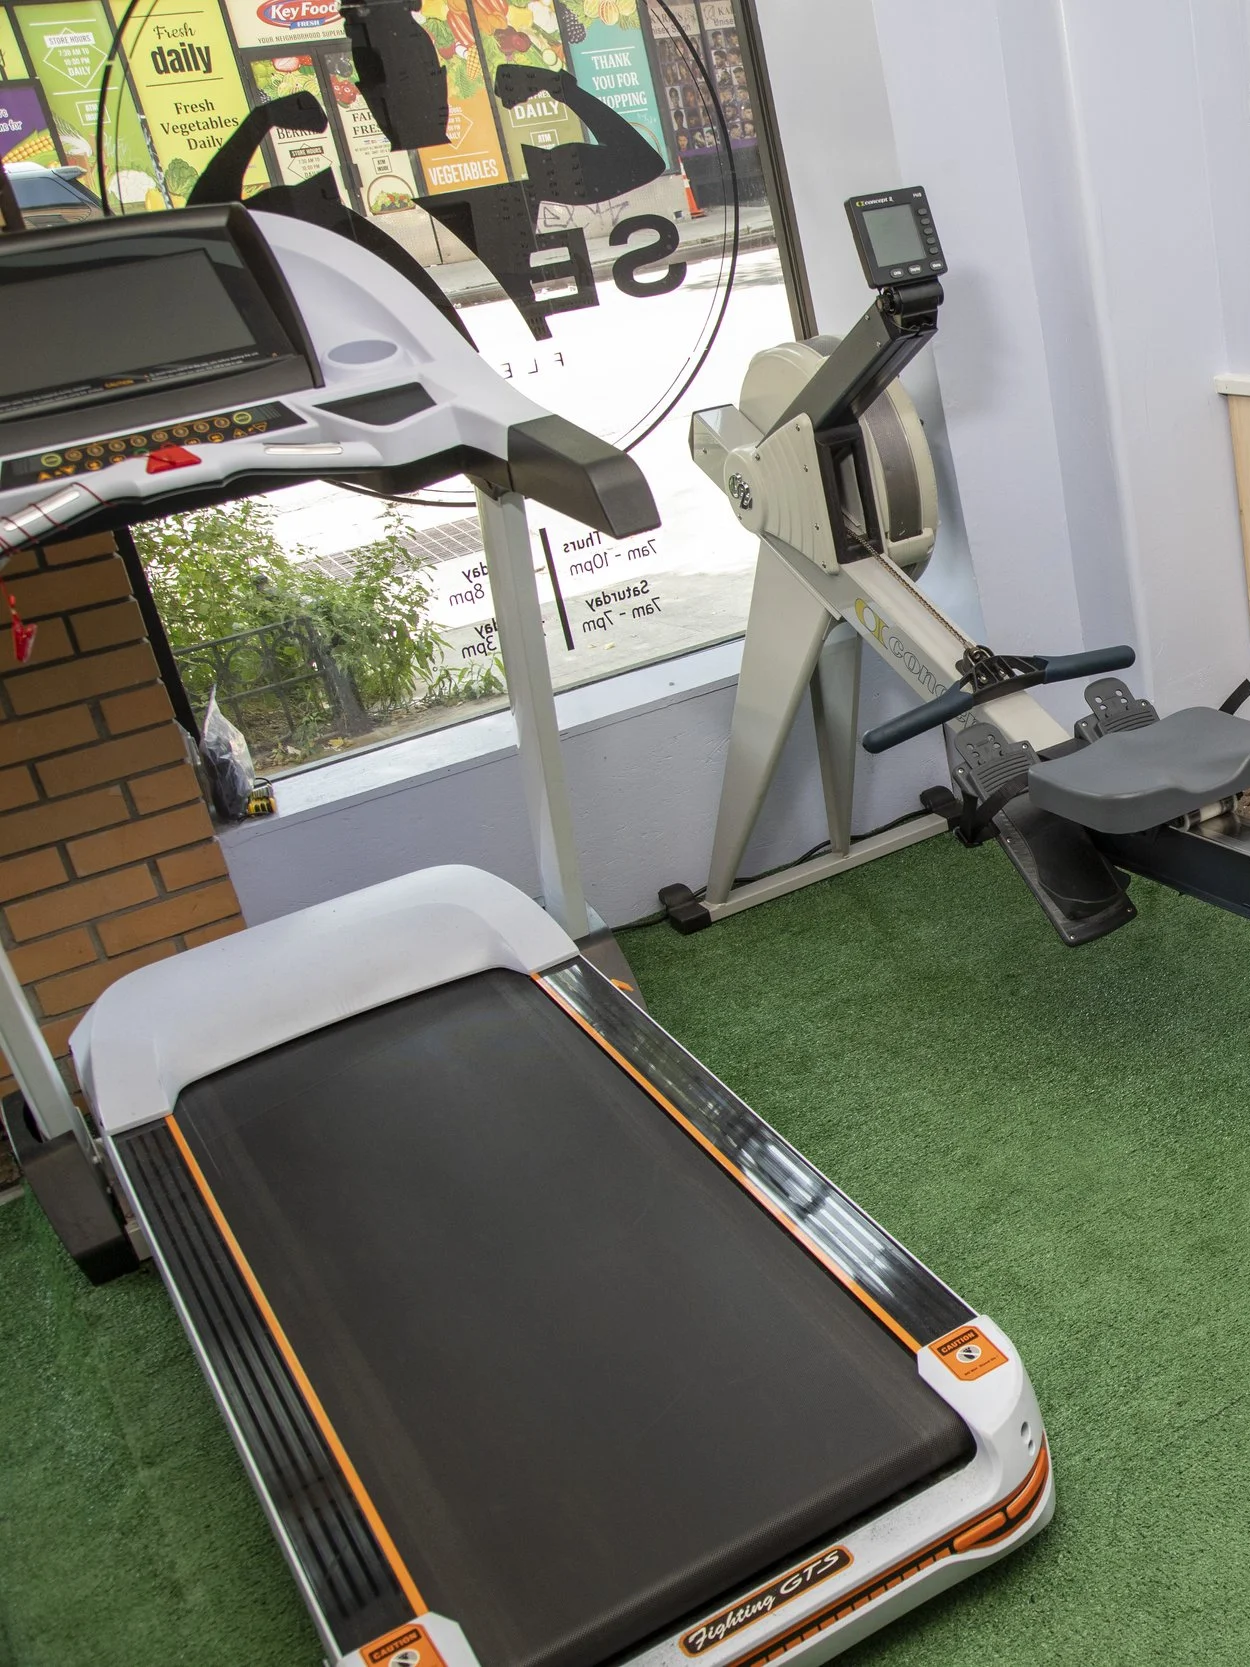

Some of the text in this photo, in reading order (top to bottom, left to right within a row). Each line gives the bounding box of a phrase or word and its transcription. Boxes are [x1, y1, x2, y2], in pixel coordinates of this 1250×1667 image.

[270, 1, 340, 21] Key Food
[153, 22, 196, 40] Fresh
[297, 19, 320, 28] FRESH
[48, 34, 92, 46] STORE HOURS
[258, 36, 274, 44] YOUR
[275, 31, 321, 43] NEIGHBORHOOD
[150, 41, 213, 75] daily
[591, 52, 633, 71] THANK
[67, 65, 91, 77] DAILY
[592, 72, 640, 91] YOU FOR
[174, 98, 216, 115] Fresh
[598, 91, 648, 110] HOPPING
[514, 101, 560, 120] DAILY
[160, 116, 240, 137] Vegetables
[186, 136, 223, 151] Daily
[537, 133, 552, 143] ATM
[292, 146, 322, 158] STORE HOURS
[428, 158, 500, 187] VEGETABLES
[940, 1331, 976, 1354] CAUTION
[688, 1549, 840, 1651] Fighting GTS
[372, 1631, 420, 1661] CAUTION
